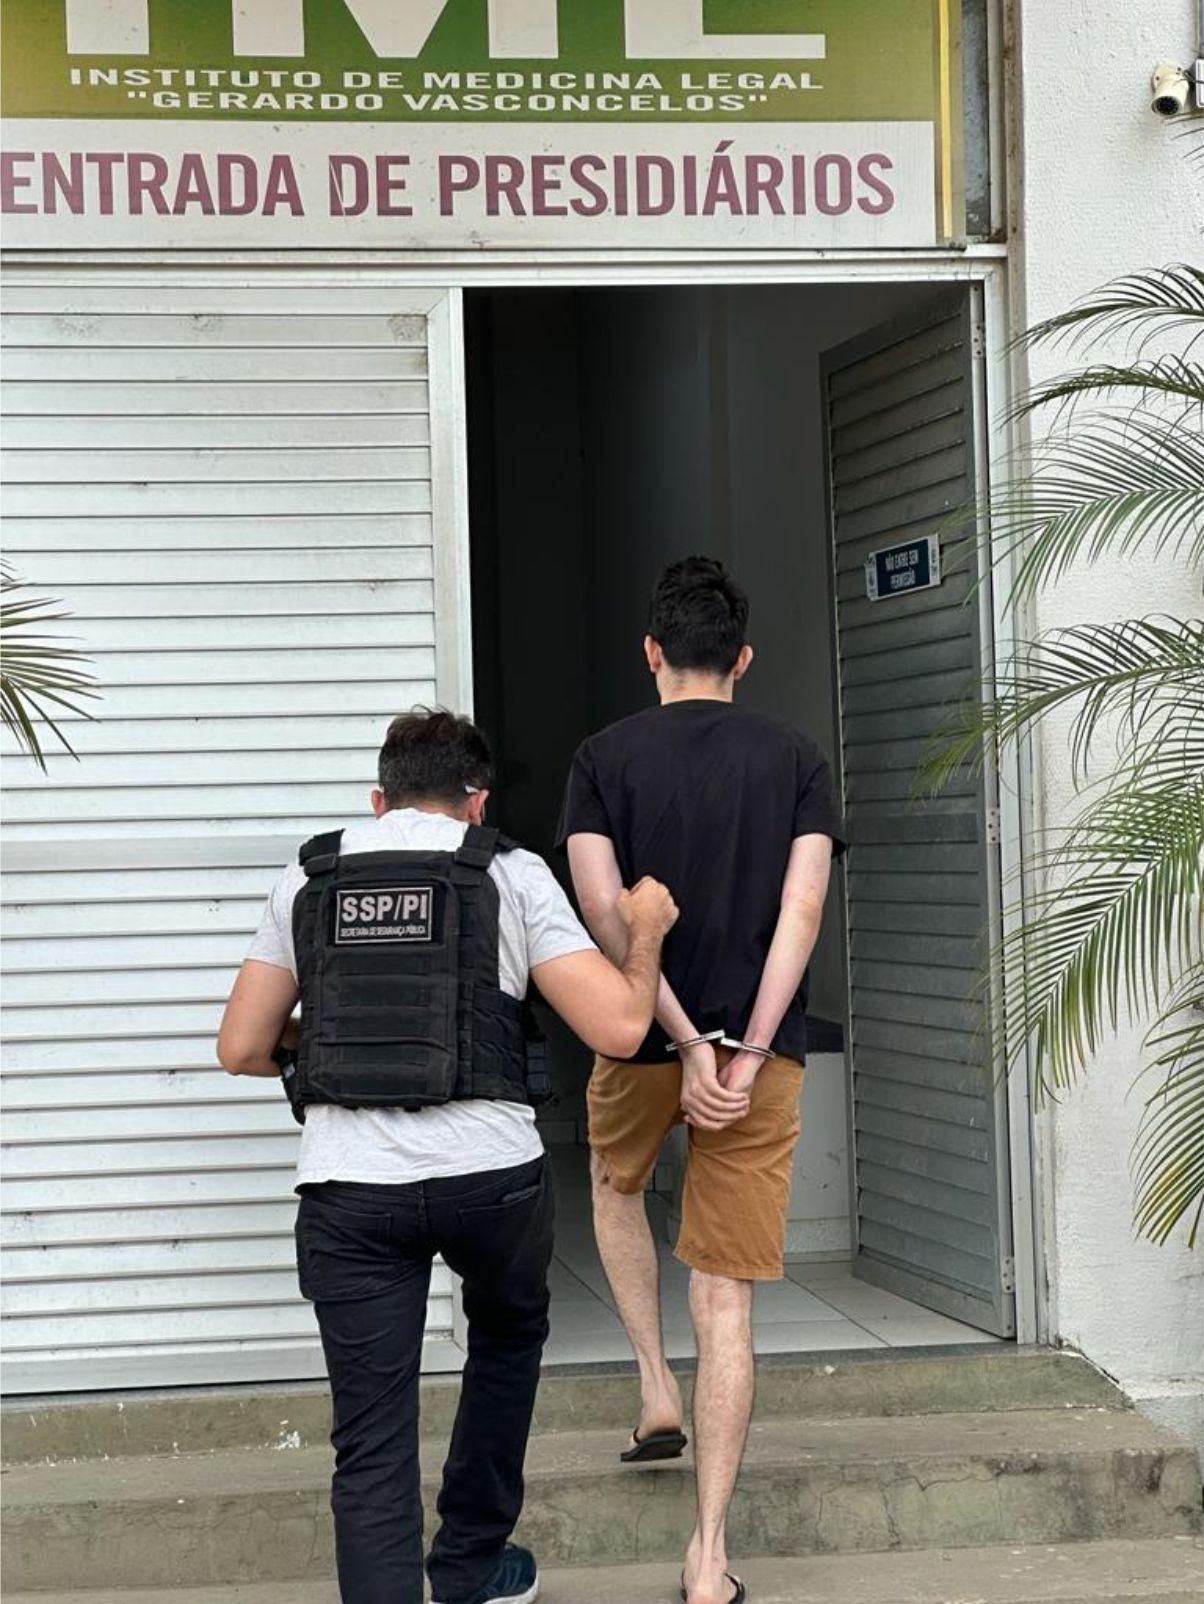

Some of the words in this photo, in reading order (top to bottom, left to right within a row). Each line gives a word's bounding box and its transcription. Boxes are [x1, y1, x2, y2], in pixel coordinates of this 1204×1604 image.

[69, 68, 321, 88] INSTITUTO
[343, 71, 403, 89] DE
[424, 72, 662, 90] MEDICINA
[681, 73, 823, 90] LEGAL
[127, 91, 383, 111] "GERARDO
[403, 94, 767, 112] VASCONCELOS"
[0, 151, 305, 217] ENTRADA
[328, 154, 413, 217] DE
[438, 139, 895, 217] PRESIDIÁRIOS
[341, 894, 428, 923] SSP/PI
